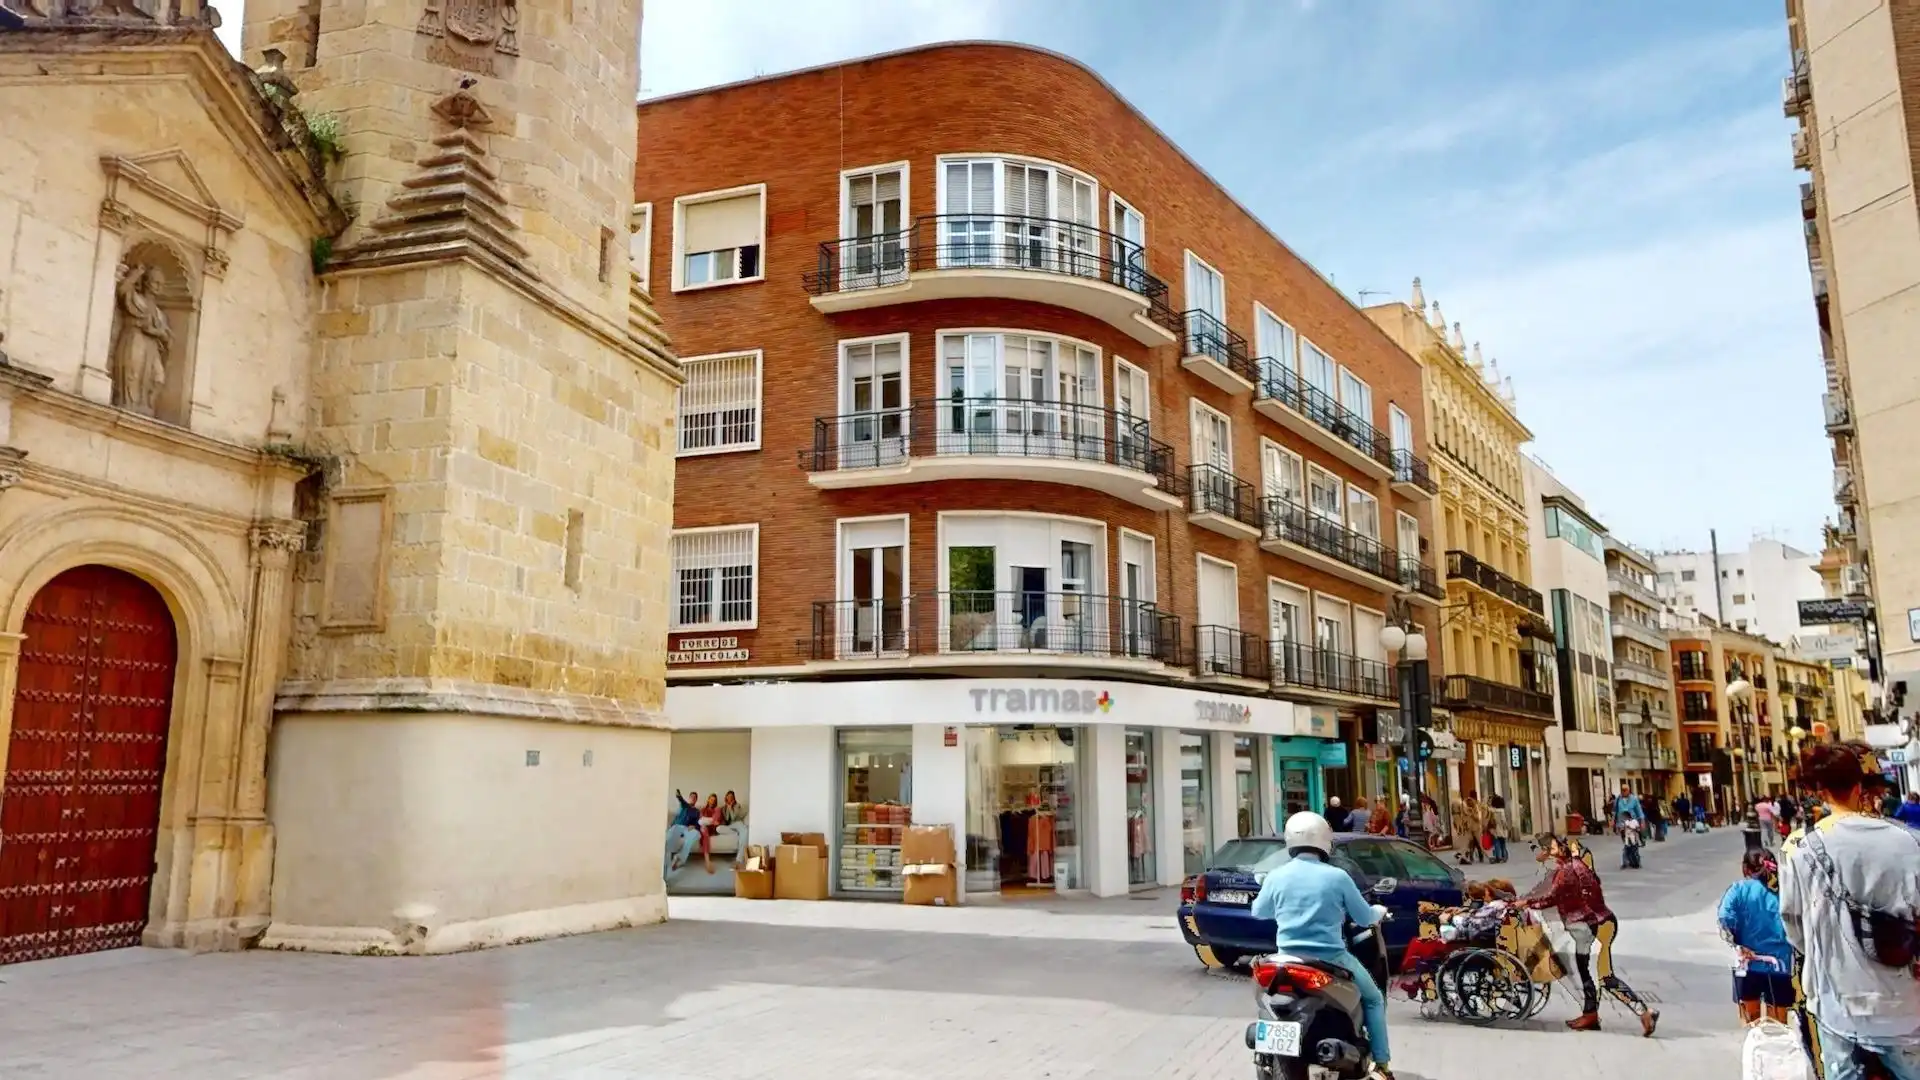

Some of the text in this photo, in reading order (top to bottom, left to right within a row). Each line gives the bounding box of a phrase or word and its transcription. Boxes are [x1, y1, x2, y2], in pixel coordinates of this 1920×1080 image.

[681, 638, 736, 649] TORRE DE
[669, 650, 747, 662] SAN NICOLAS
[1265, 1023, 1297, 1039] 7858
[1267, 1038, 1294, 1053] JGZ
